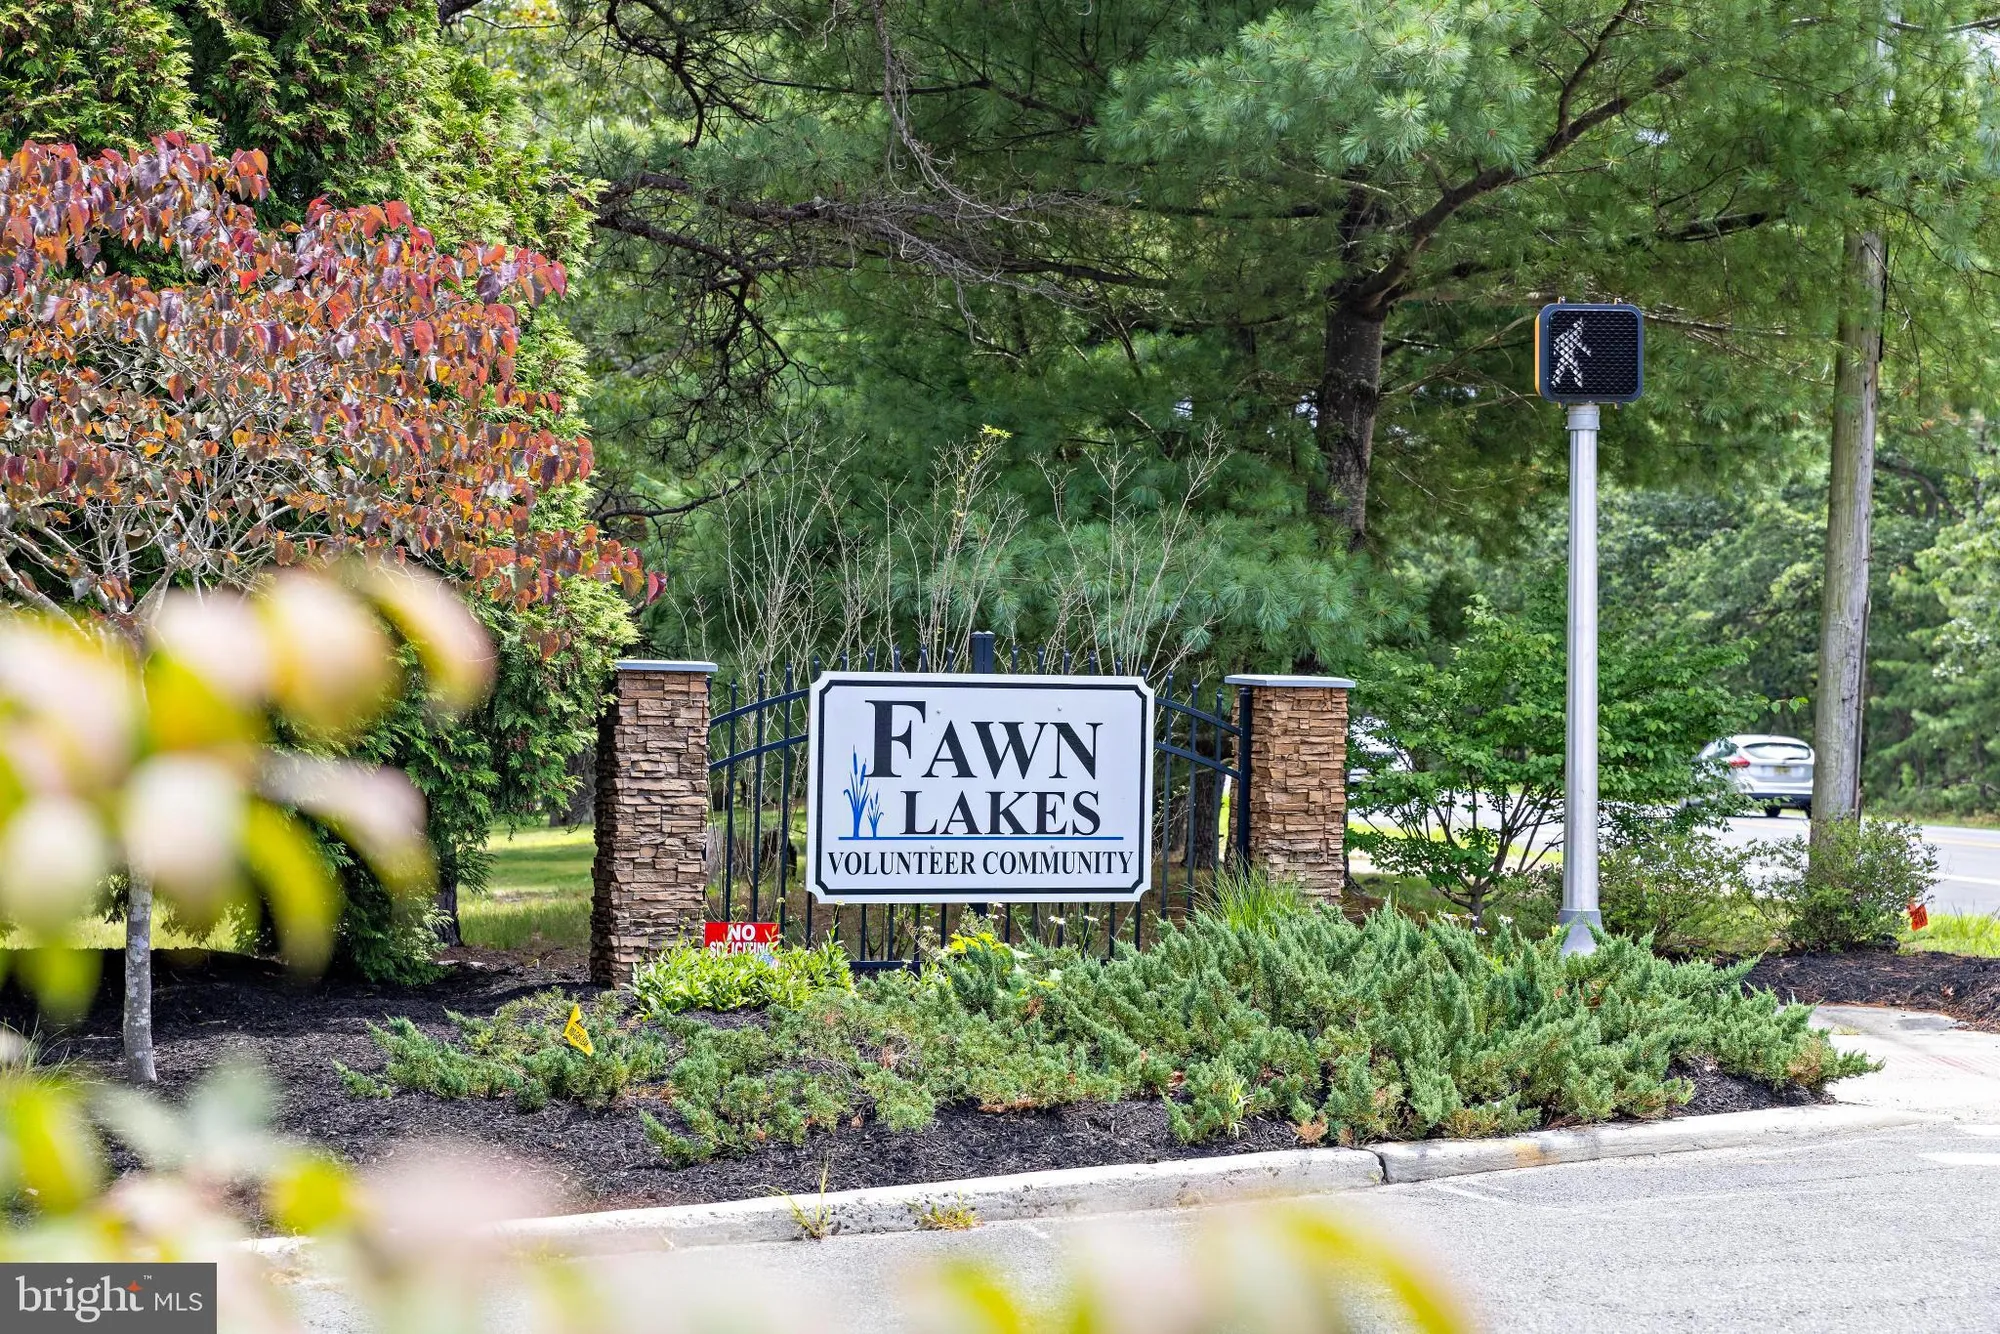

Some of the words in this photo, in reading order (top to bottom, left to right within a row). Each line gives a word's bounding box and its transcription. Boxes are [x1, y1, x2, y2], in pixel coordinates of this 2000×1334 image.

[865, 700, 1103, 779] FAWN
[900, 790, 1101, 835] LAKES
[827, 851, 977, 875] VOLUNTEER
[982, 851, 1134, 874] COMMUNITY
[727, 924, 756, 941] NO
